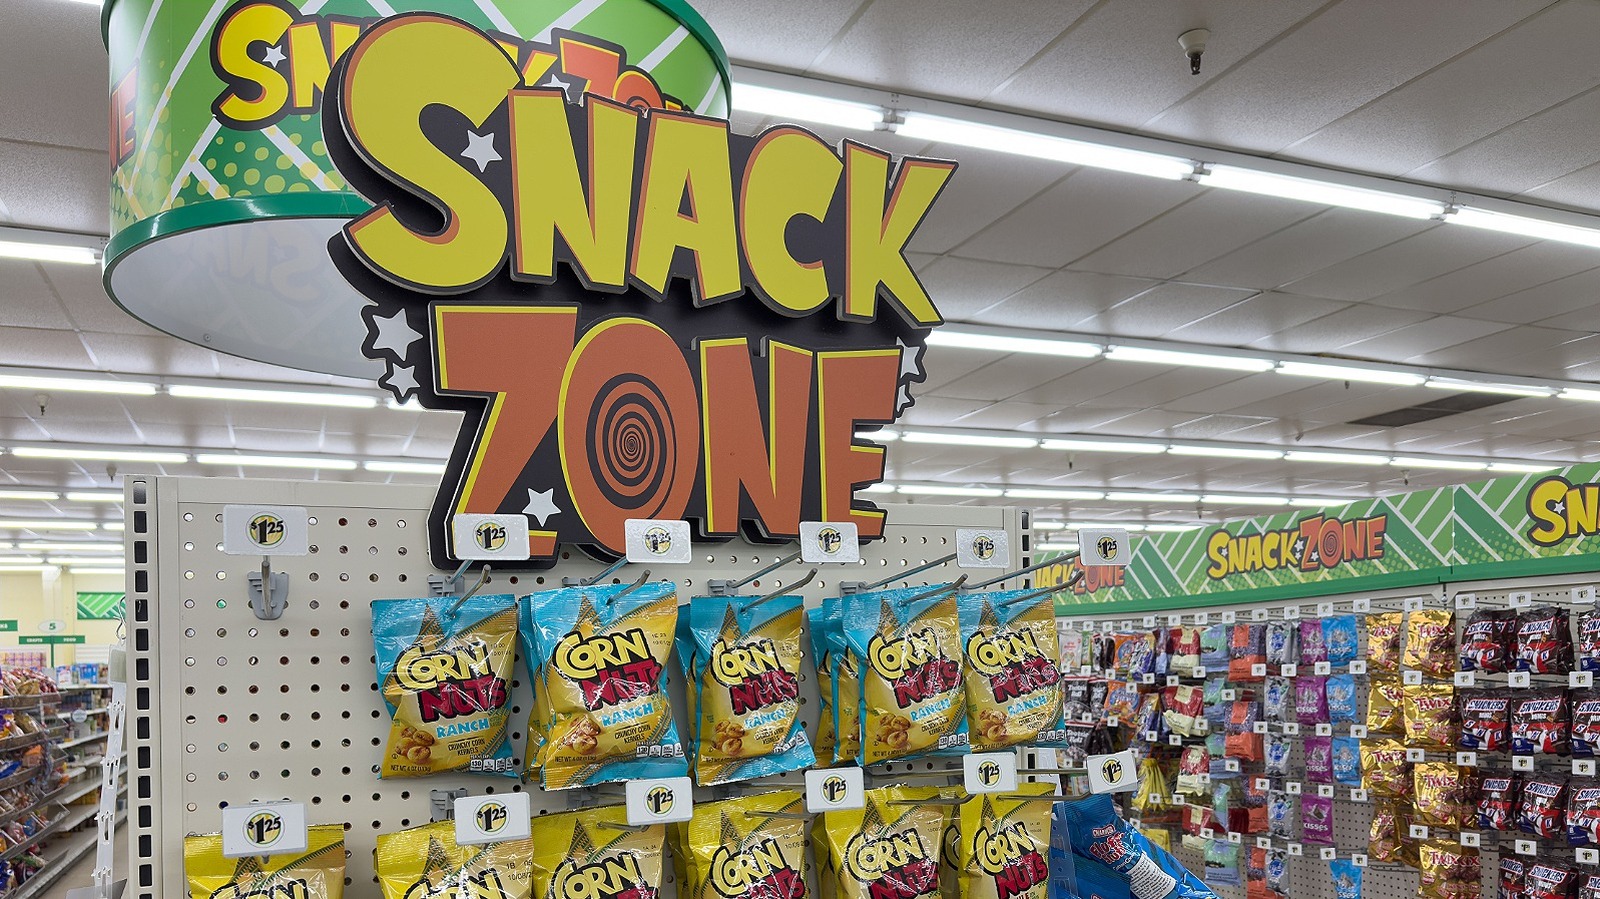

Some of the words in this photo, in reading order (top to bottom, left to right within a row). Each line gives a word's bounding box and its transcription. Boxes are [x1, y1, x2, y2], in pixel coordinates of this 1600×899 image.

[345, 13, 958, 327] SNACK
[433, 304, 901, 559] ZONE
[1208, 531, 1297, 578] SNACK
[1299, 515, 1387, 570] ZONE
[49, 622, 56, 630] 5
[395, 643, 490, 691] CORN
[555, 631, 649, 679] CORN
[711, 640, 780, 685] CORN
[869, 629, 939, 680] CORN
[968, 631, 1039, 675] CORN
[419, 675, 507, 722] NUTS
[601, 702, 654, 726] RANCH
[910, 698, 951, 721] RANCH
[1520, 700, 1560, 713] SNICKERS
[436, 718, 490, 738] RANCH
[614, 728, 637, 739] CRUNCHY
[637, 725, 651, 734] CORN
[624, 735, 645, 744] KERNELS
[712, 840, 786, 896] CORN
[848, 831, 924, 880] CORN
[975, 823, 1035, 875] CORN
[552, 853, 640, 899] CORN
[995, 851, 1049, 899] NUTS
